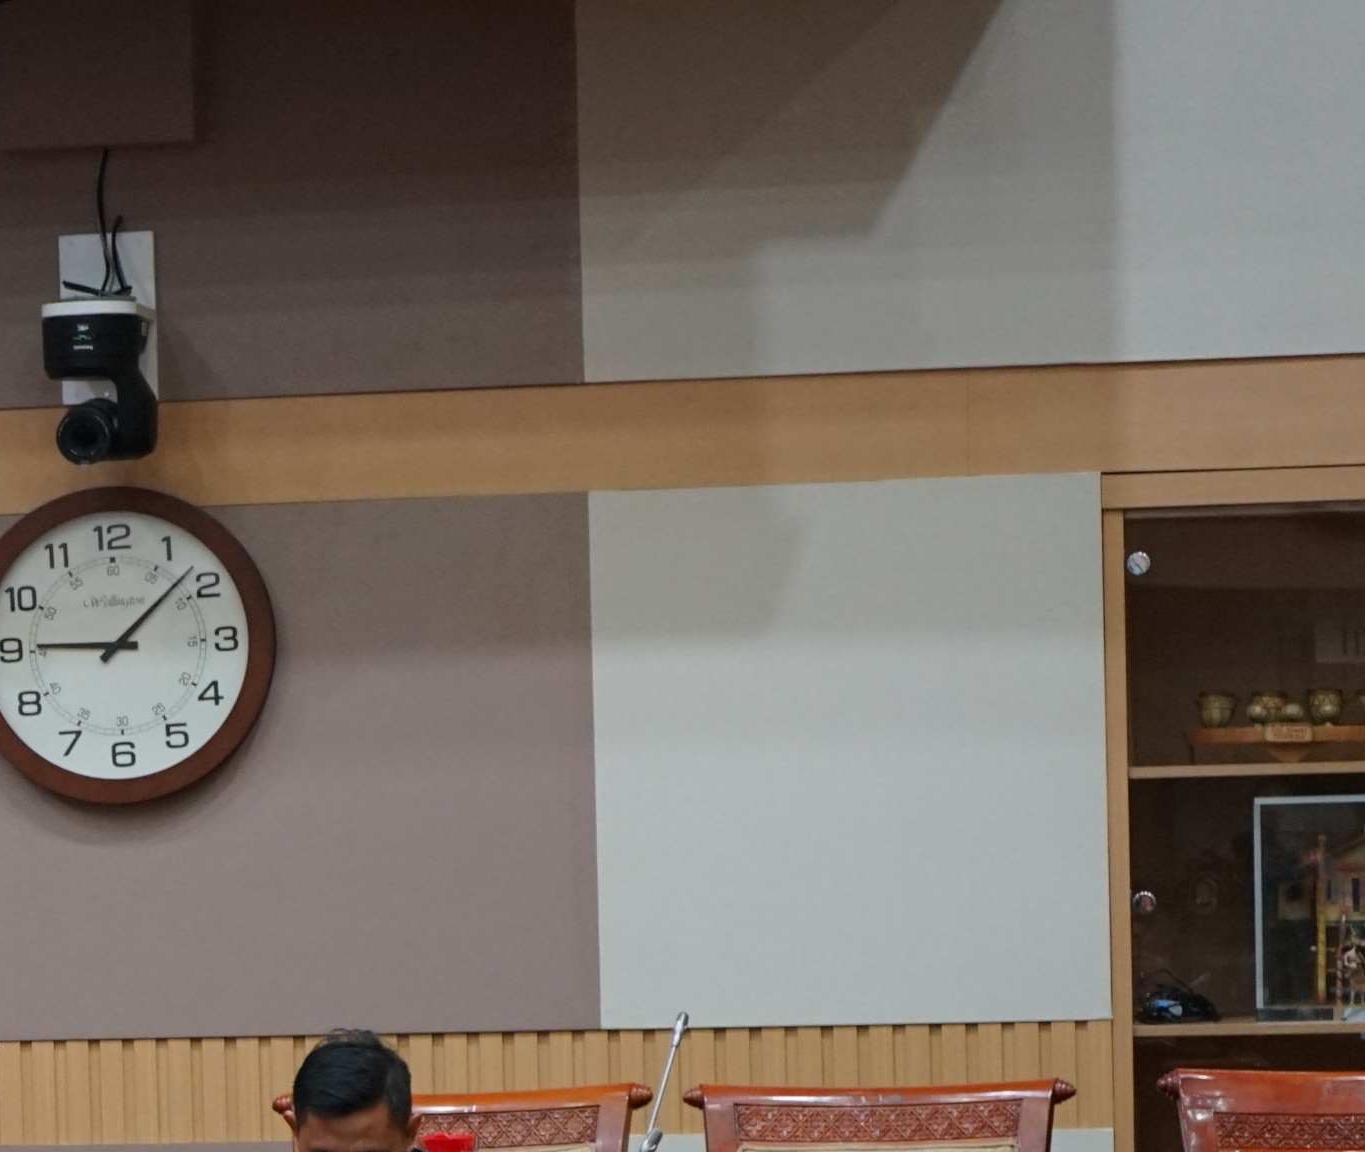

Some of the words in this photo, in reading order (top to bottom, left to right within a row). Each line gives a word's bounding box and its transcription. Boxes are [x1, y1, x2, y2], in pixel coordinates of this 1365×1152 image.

[93, 523, 132, 551] 12
[161, 536, 173, 561] 1
[44, 542, 70, 569] 11
[69, 577, 84, 591] 55
[106, 566, 120, 577] 60
[144, 571, 159, 585] 05
[195, 572, 221, 599] 2
[4, 586, 38, 612] 10
[43, 606, 58, 621] 50
[0, 637, 24, 663] 9
[187, 634, 197, 648] 15
[214, 626, 239, 651] 3
[48, 680, 62, 695] 40
[178, 671, 192, 687] 20
[17, 690, 42, 716] 8
[197, 680, 224, 706] 4
[77, 707, 91, 721] 35
[115, 716, 129, 728] 30
[151, 703, 166, 717] 25
[58, 730, 83, 756] 7
[165, 723, 189, 748] 5
[111, 742, 136, 767] 6
